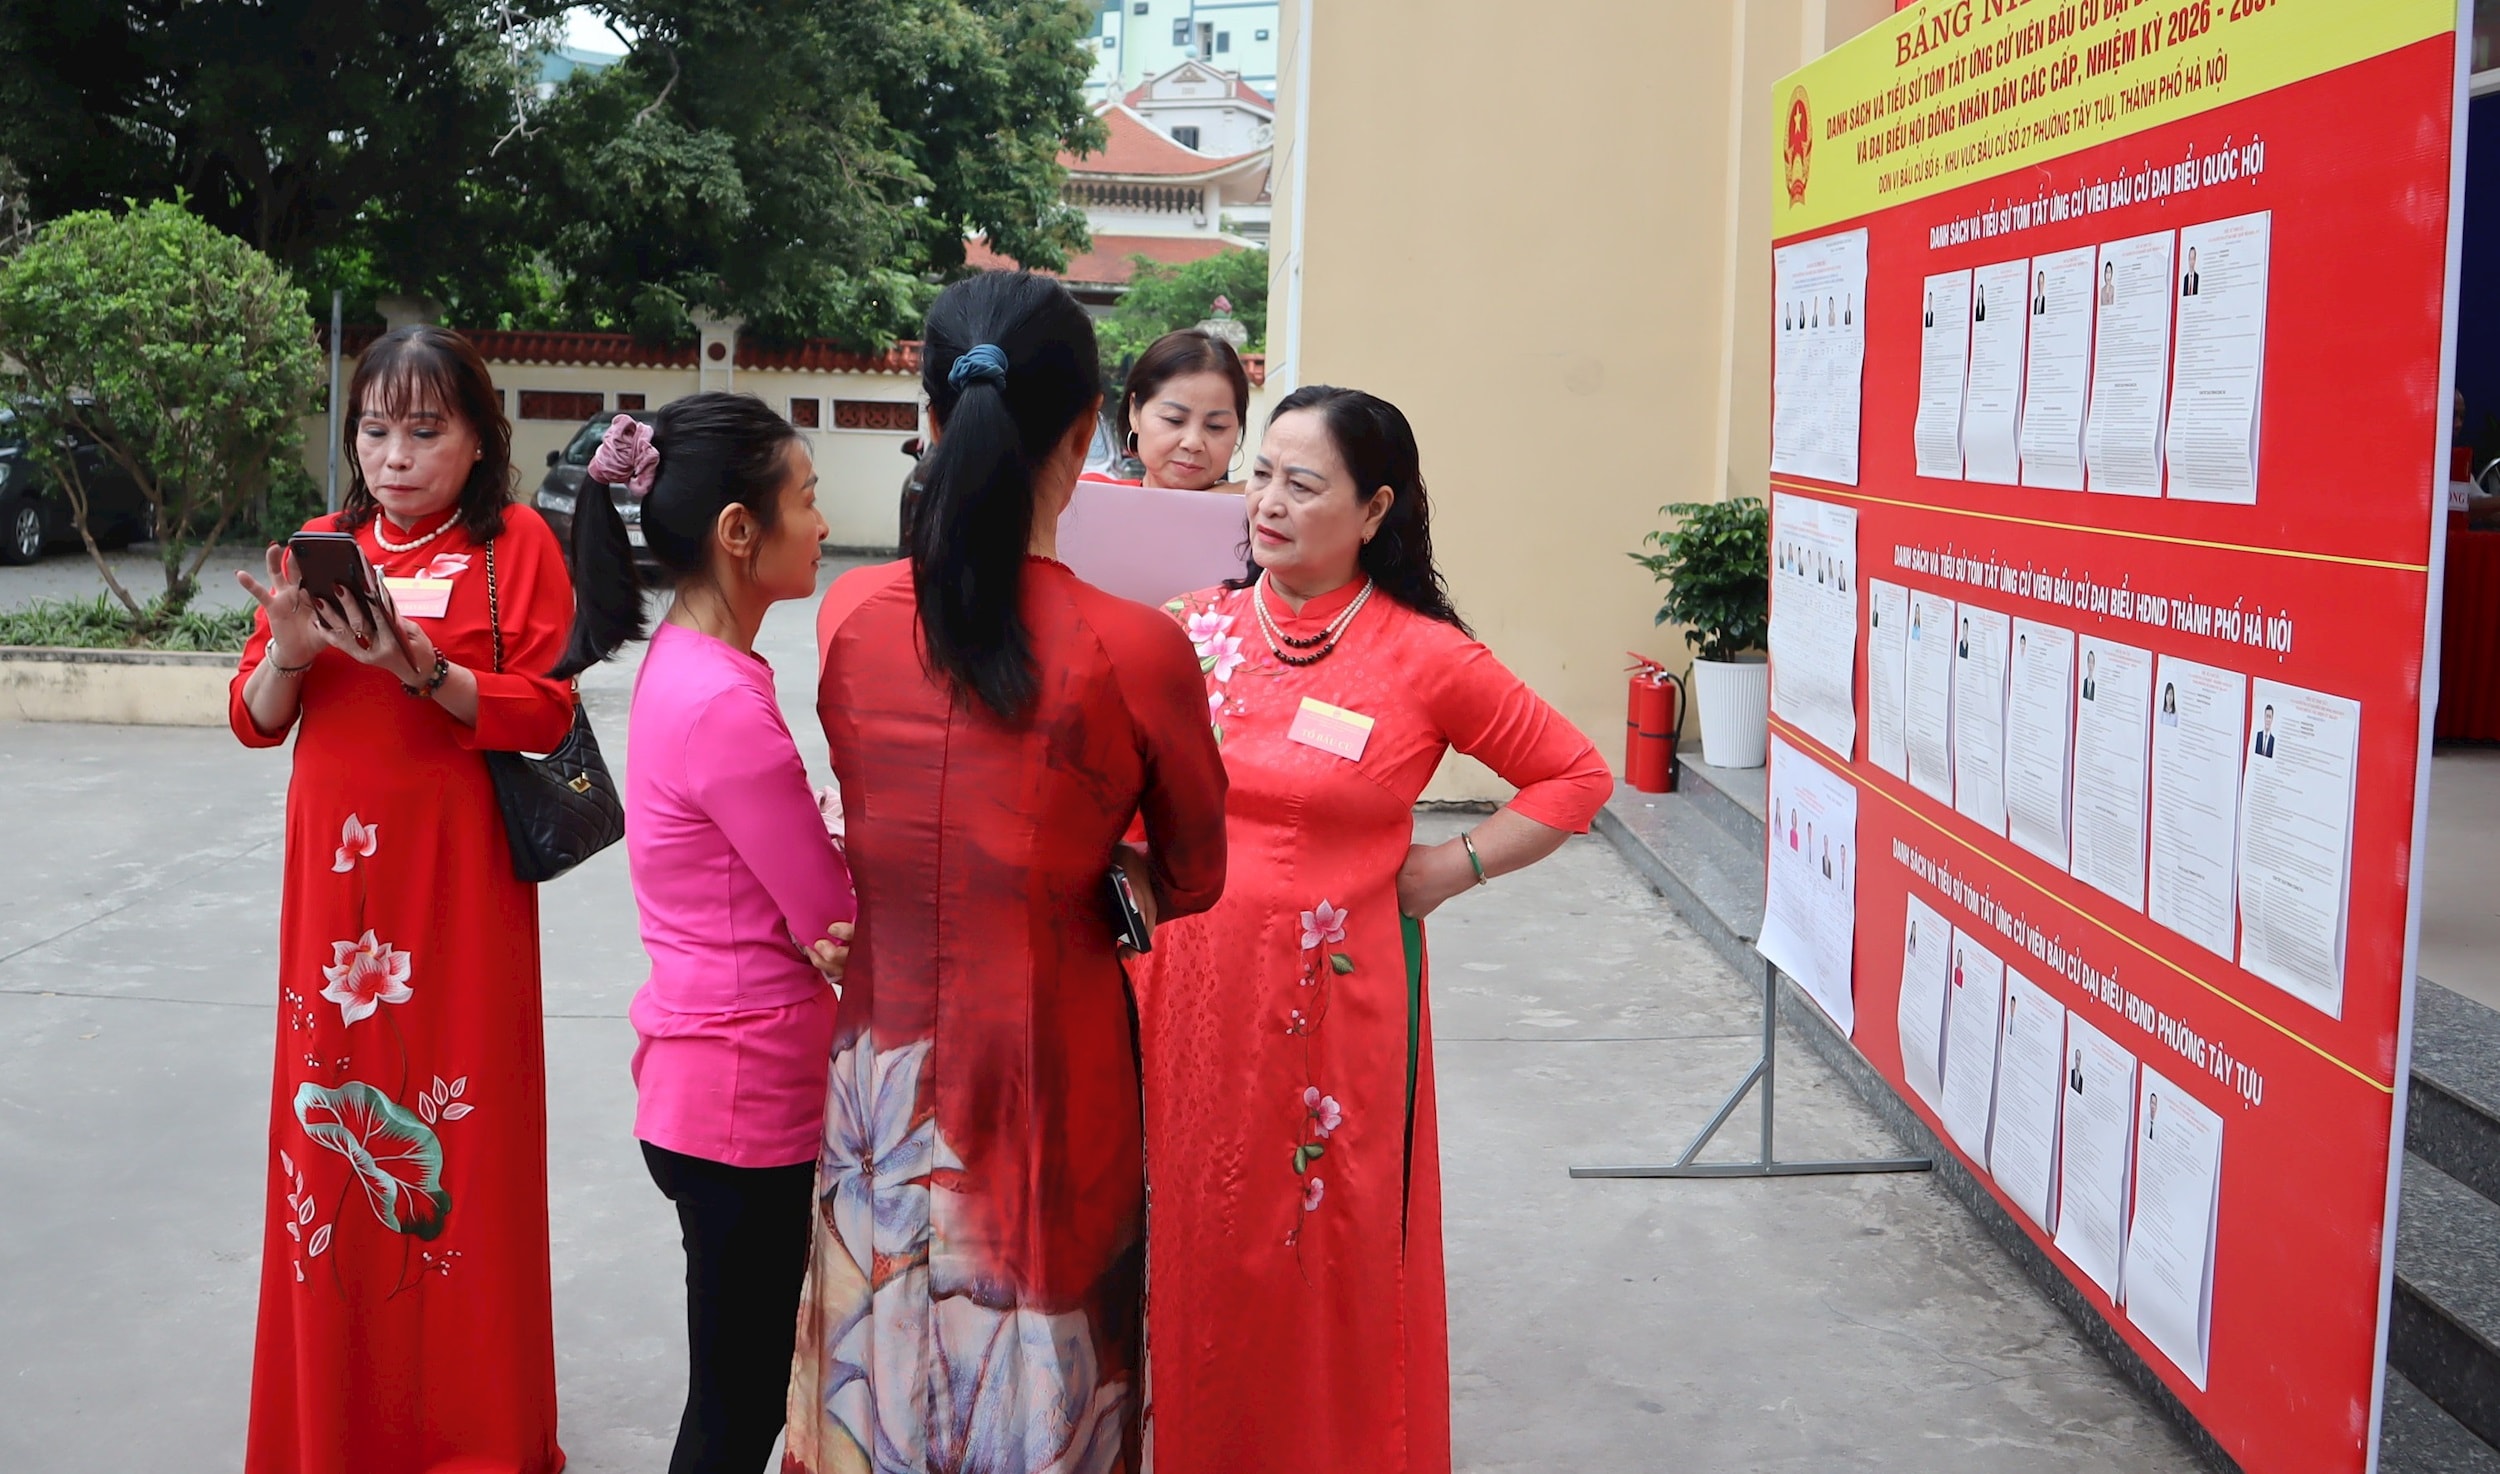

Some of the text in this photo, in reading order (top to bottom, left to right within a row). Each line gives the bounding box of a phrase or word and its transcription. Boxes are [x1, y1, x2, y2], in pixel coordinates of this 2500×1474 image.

[1826, 110, 1848, 140] DANH
[1849, 100, 1871, 131] SÁCH
[1873, 90, 1884, 120] VÀ
[1908, 68, 1923, 106] SỬ
[1924, 65, 1945, 99] TÓM
[1969, 44, 1992, 79] ỨNG
[1996, 24, 2014, 68] CỬ
[2015, 19, 2045, 59] VIÊN
[1857, 134, 1867, 165] VÀ
[1869, 132, 1884, 164] ĐẠI
[1886, 115, 1907, 154] BIỂU
[1909, 113, 1925, 149] HỘI
[1927, 100, 1955, 139] ĐỒNG
[1958, 88, 1989, 127] NHÂN
[1992, 77, 2017, 115] DÂN
[2021, 64, 2046, 104] CÁC
[2050, 45, 2082, 92] CẤP,
[2086, 29, 2137, 78] NHIỆM
[2141, 11, 2163, 57] KỲ
[2167, 0, 2211, 47] 2026
[2217, 7, 2224, 16] -
[1895, 0, 1973, 67] BẢNG
[1924, 148, 1935, 180] SỐ
[1935, 157, 1940, 177] 6
[1944, 149, 1960, 173] KHU
[1960, 143, 1976, 174] VỰC
[2008, 117, 2020, 152] SỐ
[2021, 127, 2032, 149] 27
[2033, 109, 2070, 145] PHƯỜNG
[2073, 99, 2092, 132] TÂY
[2120, 78, 2156, 116] THÀNH
[2159, 57, 2184, 103] PHỐ
[2185, 56, 2202, 94] HÀ
[2205, 47, 2228, 93] NỘI
[1929, 133, 2265, 250] DANH SÁCH VÀ TIỂU SỬ TÓM TẮT ỨNG CỬ VIÊN BẦU CỬ ĐẠI BIỂU QUỐC HỘI
[1893, 542, 2293, 664] DANH SÁCH VÀ TIỂU SỬ TÓM TẮT ỨNG CỬ VIÊN BẦU CỬ ĐẠI BIỂU HĐND THÀNH PHỐ HÀ NỘI
[1892, 837, 2264, 1110] DANH SÁCH VÀ TIỂU SỬ TÓM TẮT ỨNG CỬ VIÊN BẦU CỬ ĐẠI BIỂU HĐND PHƯỜNG TÂY TỰU
